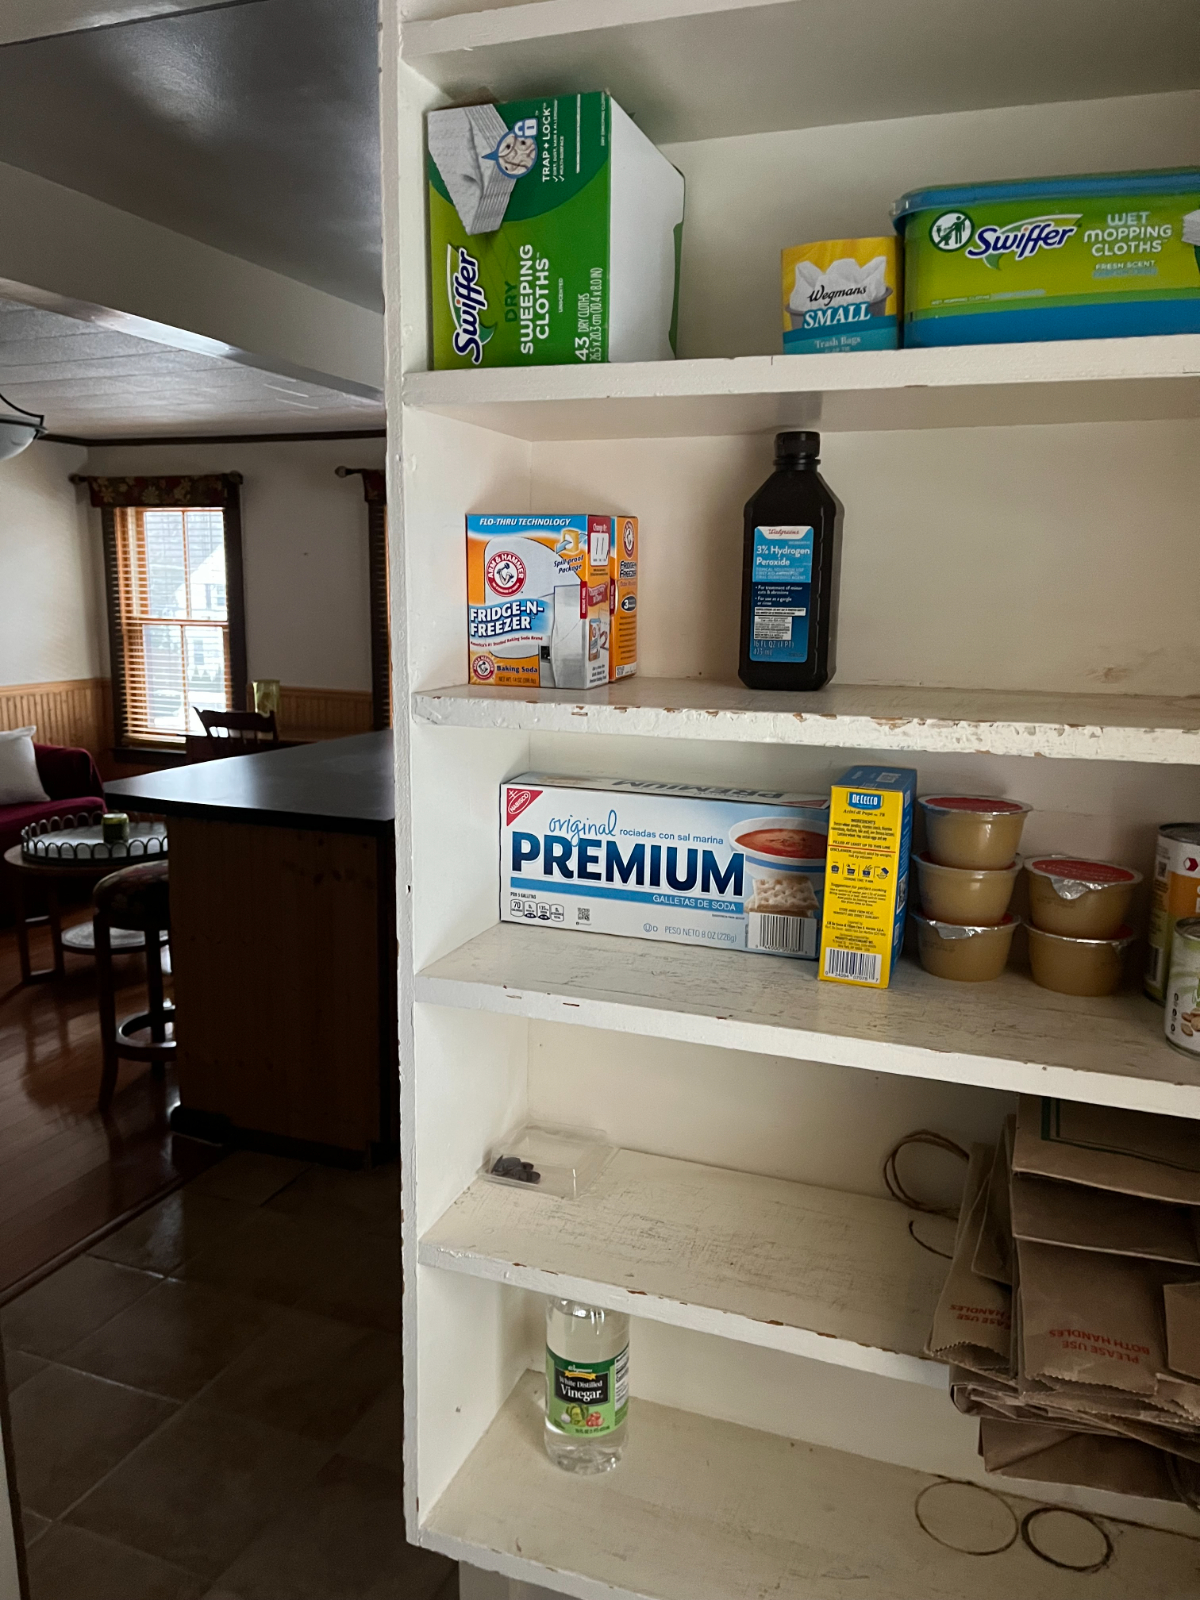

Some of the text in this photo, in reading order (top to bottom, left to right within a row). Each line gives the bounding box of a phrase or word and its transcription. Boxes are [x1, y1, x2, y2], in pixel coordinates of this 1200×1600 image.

[542, 151, 551, 183] TRAP
[1107, 211, 1151, 227] WET
[965, 222, 1076, 260] Swiffer
[1083, 224, 1172, 243] MOPPING
[1095, 260, 1155, 270] FRESH SCENT
[590, 279, 602, 290] 8.0
[504, 281, 518, 323] DRY
[520, 244, 534, 355] SWEEPING
[807, 284, 867, 306] Wegmans
[454, 248, 487, 364] Swiffer
[804, 303, 871, 329] SMALL
[575, 293, 590, 361] 43 DRY CLOTHS
[590, 326, 601, 341] 20.3
[814, 336, 861, 349] Trash Bags
[479, 518, 572, 526] FLO-THRU TECHNOLOGY
[756, 545, 810, 558] 3% Hydrogen
[488, 560, 497, 578] ARM
[501, 554, 524, 578] HAMMER
[558, 564, 582, 574] Package
[756, 557, 790, 566] Peroxide
[470, 601, 544, 621] FRIDGE-N-
[624, 600, 629, 609] 3
[470, 616, 531, 637] FREEZER
[497, 665, 520, 674] Baking
[612, 780, 784, 799] PREMIUM
[509, 792, 529, 813] NABISCO
[549, 809, 617, 848] original
[619, 828, 724, 845] rociadas con sal marina
[511, 831, 745, 897] PREMIUM
[513, 901, 520, 909] 70
[653, 895, 695, 907] GALLETAS
[711, 902, 736, 911] SODA
[665, 926, 681, 935] PESO
[682, 929, 700, 938] NETO
[701, 930, 706, 938] 8
[708, 931, 716, 939] OZ
[1049, 1329, 1150, 1355] BOTH HANDLES
[1062, 1341, 1139, 1364] PLEASE USE
[560, 1383, 602, 1402] Vinegar
[577, 1380, 603, 1388] Distilled
